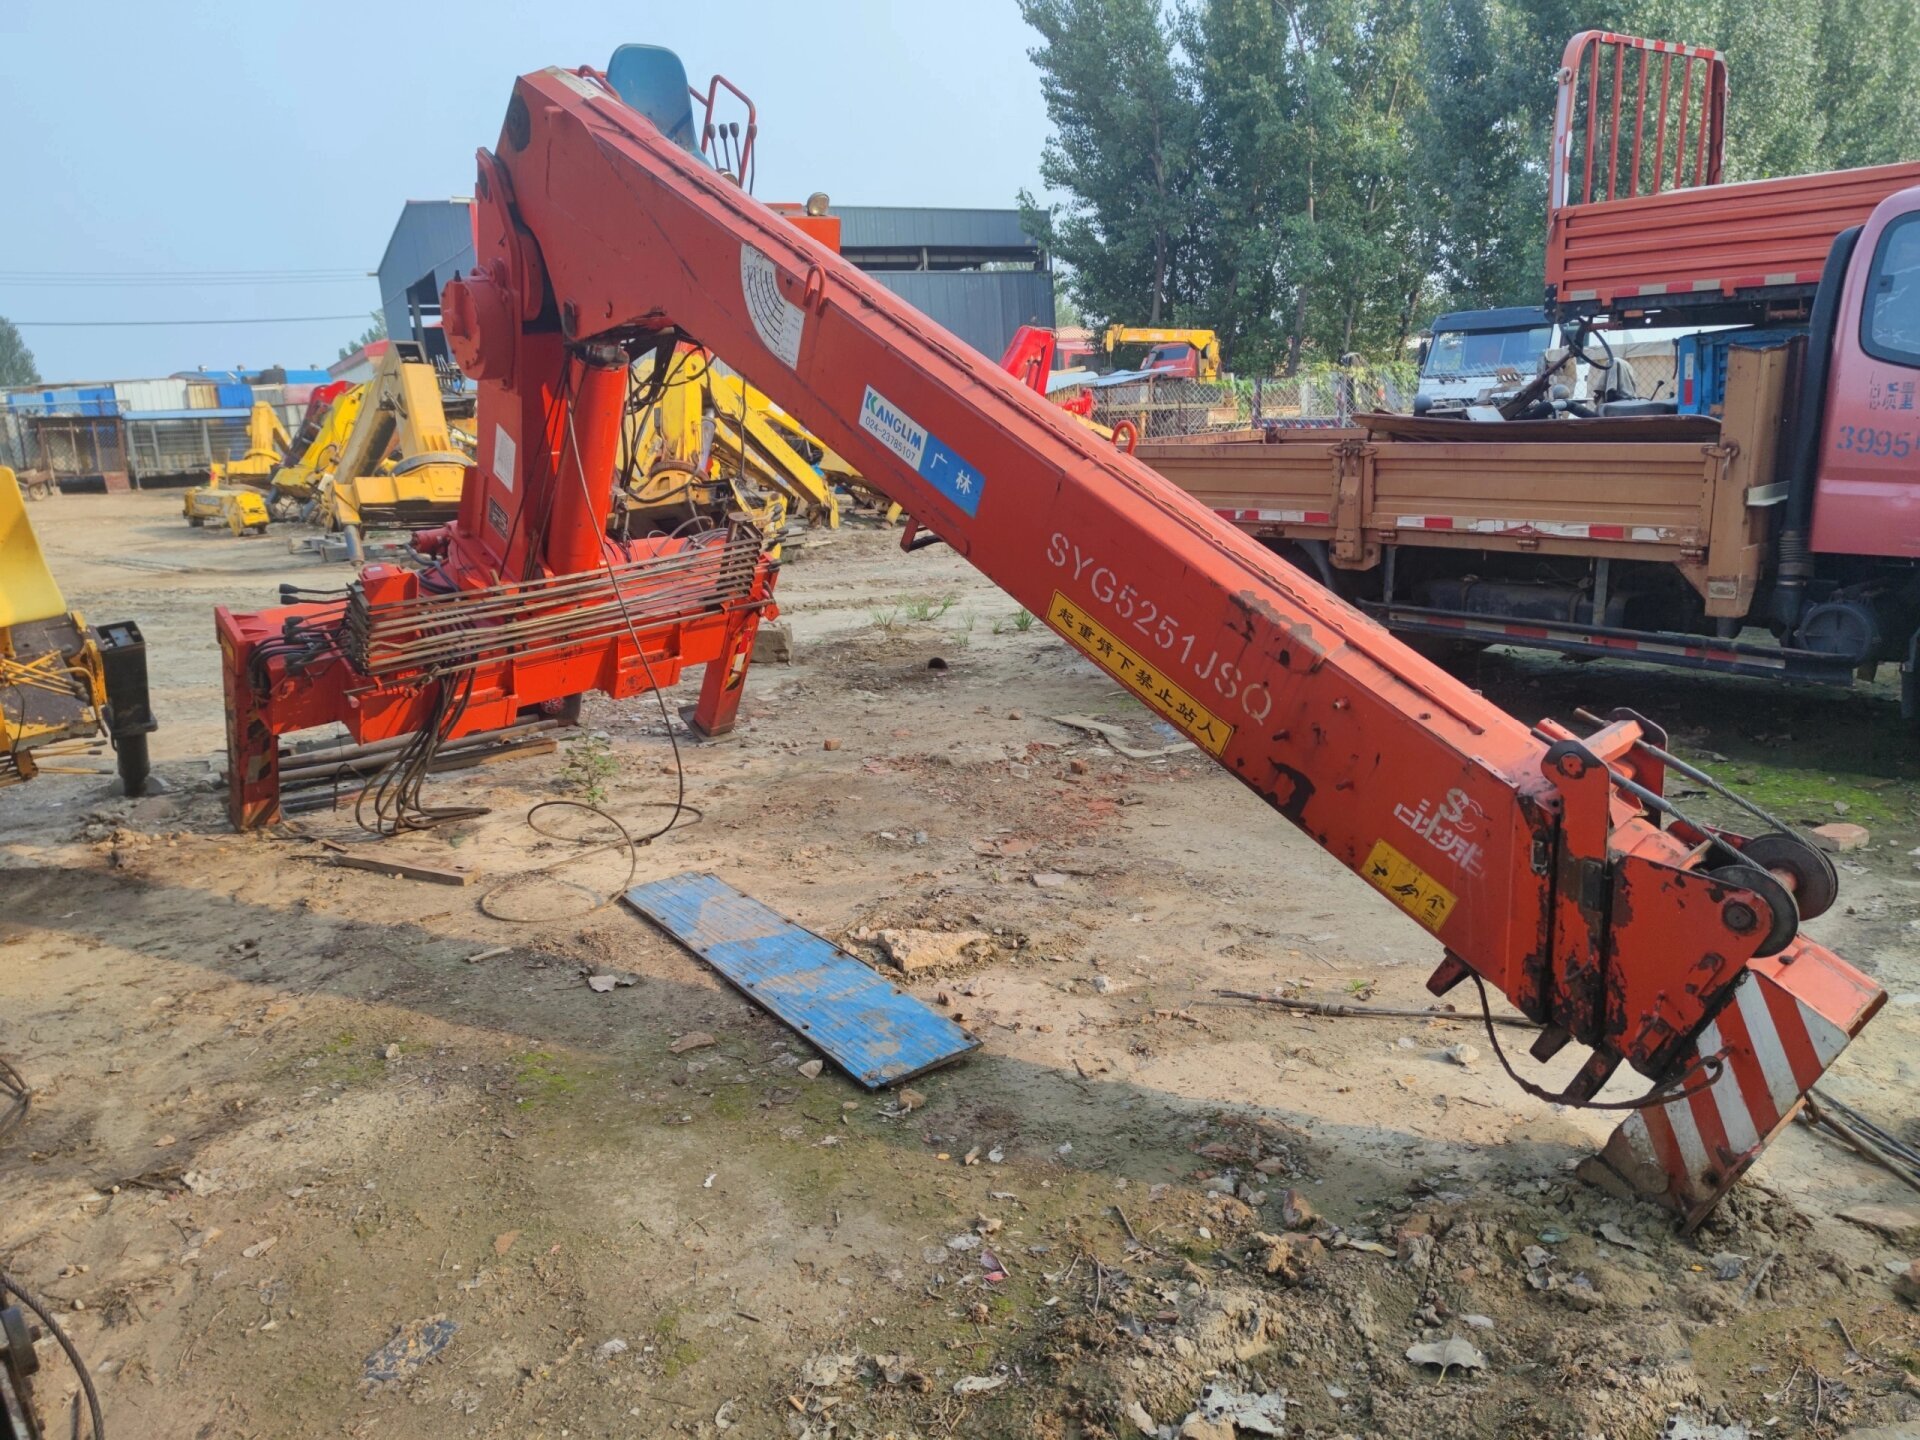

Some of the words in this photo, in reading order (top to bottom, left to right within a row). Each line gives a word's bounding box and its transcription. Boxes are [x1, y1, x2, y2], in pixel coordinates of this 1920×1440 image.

[864, 415, 916, 462] 024-23785107
[865, 390, 922, 452] KANGLIM
[930, 451, 972, 495] 广林
[1047, 532, 1272, 725] SYG5251JSQ
[1057, 607, 1216, 743] 起重臂下禁止站人
